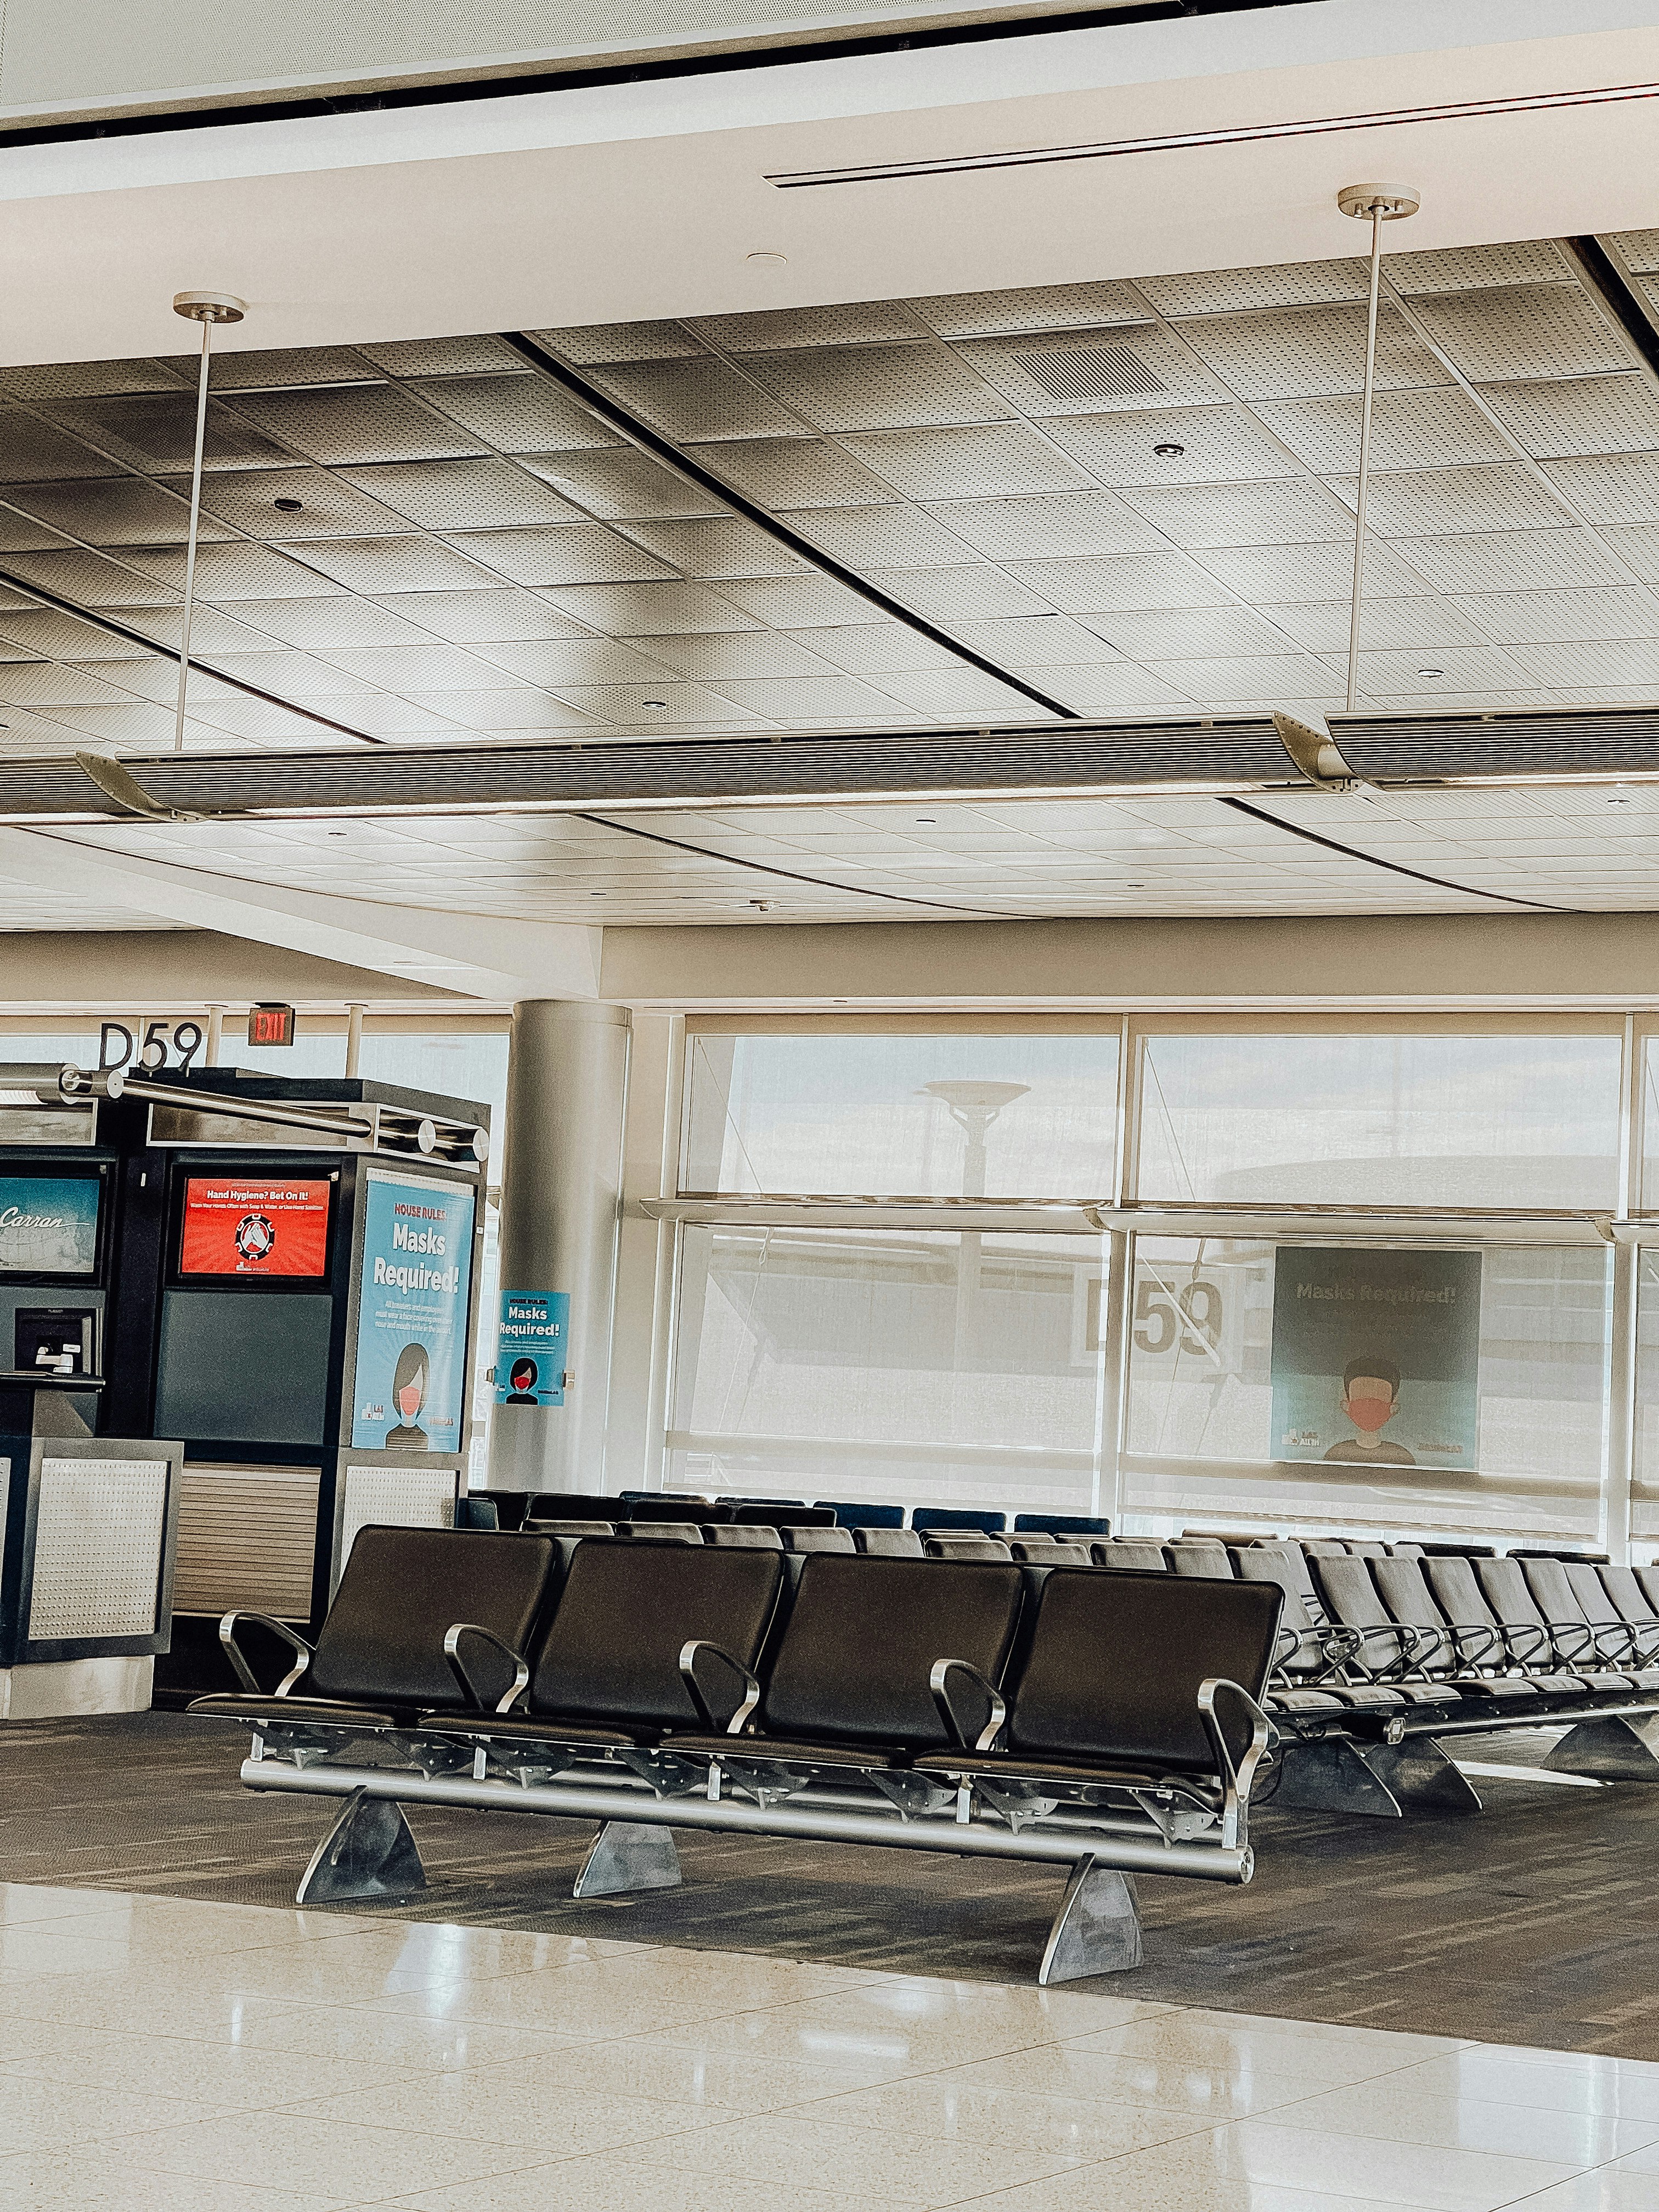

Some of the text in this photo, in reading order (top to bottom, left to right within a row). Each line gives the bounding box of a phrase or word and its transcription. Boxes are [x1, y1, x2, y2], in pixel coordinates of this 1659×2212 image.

[256, 1013, 286, 1040] EXIT
[207, 1190, 308, 1201] Hand Hygiene? Bet On It!
[394, 1203, 421, 1218] HOUSE
[393, 1222, 445, 1256] Masks
[374, 1256, 460, 1295] Required!
[1296, 1282, 1455, 1306] Masks Required!
[509, 1306, 548, 1320] Masks
[499, 1322, 560, 1338] Required!
